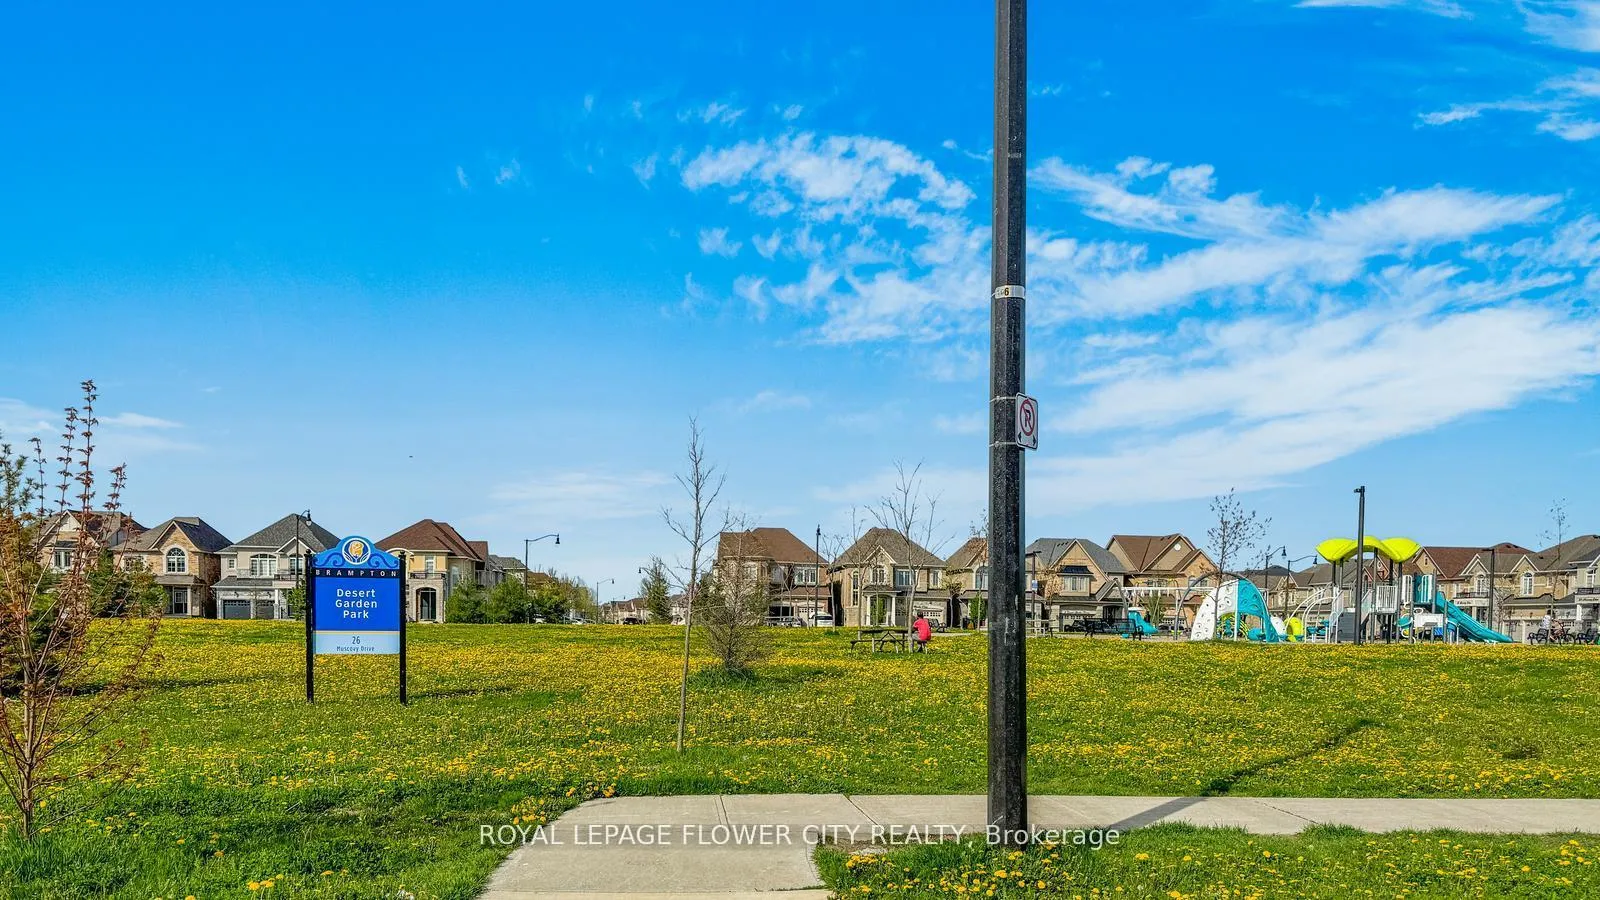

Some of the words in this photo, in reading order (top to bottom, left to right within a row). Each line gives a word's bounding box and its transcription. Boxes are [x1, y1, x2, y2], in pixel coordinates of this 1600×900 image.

[315, 569, 397, 577] BRAMPTON
[336, 588, 376, 598] Desert
[335, 599, 378, 608] Garden
[343, 609, 369, 619] Park
[351, 635, 361, 645] 26
[336, 645, 359, 653] Muscovy
